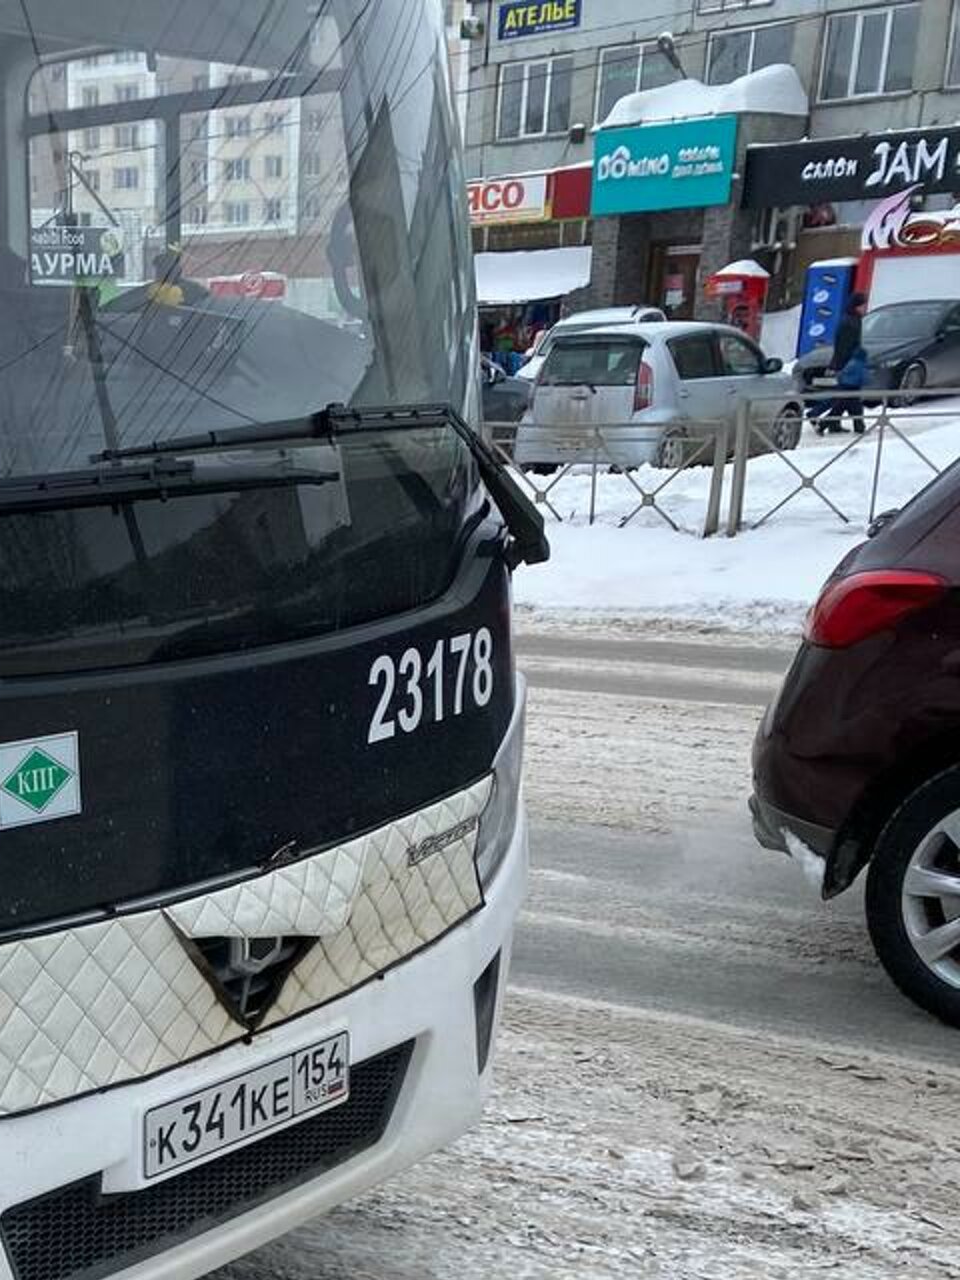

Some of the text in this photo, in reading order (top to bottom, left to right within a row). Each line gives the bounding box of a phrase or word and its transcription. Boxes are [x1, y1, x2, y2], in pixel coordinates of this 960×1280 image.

[504, 0, 576, 30] АТЕЛЬЕ
[865, 136, 949, 187] JAM
[367, 626, 493, 744] 23178
[17, 766, 59, 795] КПГ
[158, 1041, 343, 1165] К341КЕ 154
[304, 1083, 328, 1103] RUS
